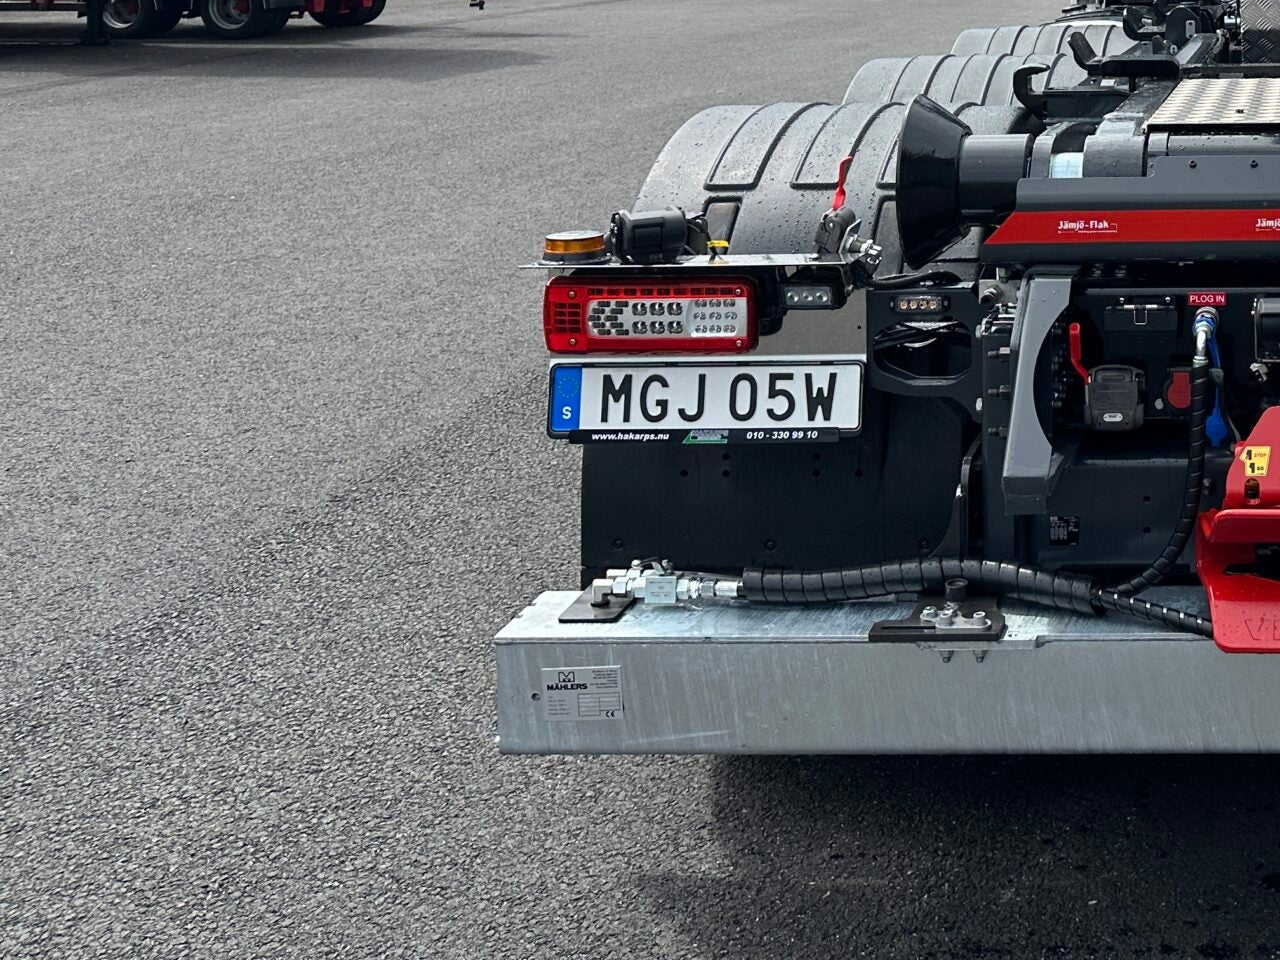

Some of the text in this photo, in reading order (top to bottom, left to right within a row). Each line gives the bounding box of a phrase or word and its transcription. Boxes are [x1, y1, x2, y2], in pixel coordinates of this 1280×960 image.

[1057, 220, 1109, 231] Jämjö-Flak
[1190, 294, 1225, 303] PLOG IN
[600, 372, 838, 423] MGJ 05W
[562, 406, 572, 420] S
[591, 431, 669, 441] www.hakarps.nu
[746, 431, 763, 439] 010
[772, 431, 789, 439] 330
[791, 431, 804, 439] 99
[806, 430, 818, 439] 10
[546, 683, 588, 691] MÄHLERS
